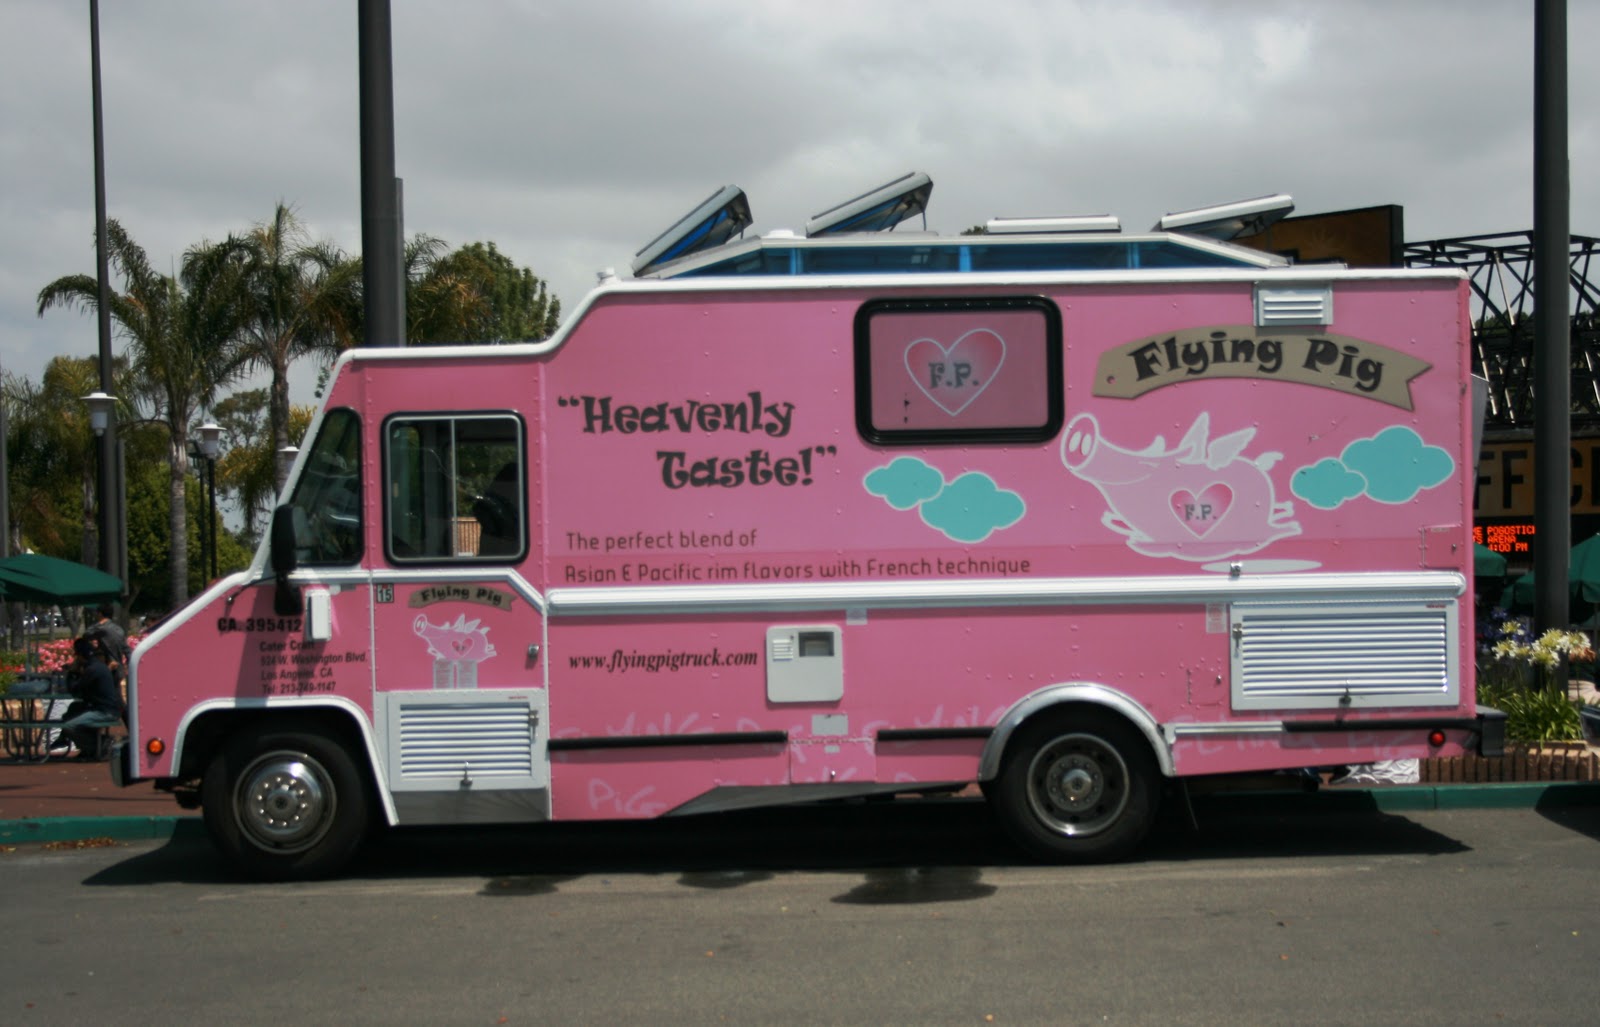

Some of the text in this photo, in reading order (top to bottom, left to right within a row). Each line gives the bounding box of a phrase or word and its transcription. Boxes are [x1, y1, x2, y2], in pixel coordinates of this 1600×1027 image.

[1127, 331, 1384, 392] Flying Pig
[928, 362, 980, 389] F.P.
[566, 529, 758, 553] The perfect blend of
[1487, 534, 1517, 544] ARENA
[1515, 542, 1529, 552] PM
[565, 564, 617, 583] Asian
[638, 562, 702, 582] Pacific
[707, 562, 739, 581] rim
[744, 562, 813, 581] flavors
[819, 560, 862, 578] with
[866, 557, 932, 577] French
[937, 556, 1031, 577] technique
[378, 589, 392, 602] 15
[421, 586, 503, 606] Flying Pig
[246, 618, 303, 632] 395412
[291, 653, 345, 667] Washington
[568, 648, 758, 673] www.flyingpigtruck.com
[261, 670, 277, 681] Los
[320, 667, 333, 678] CA
